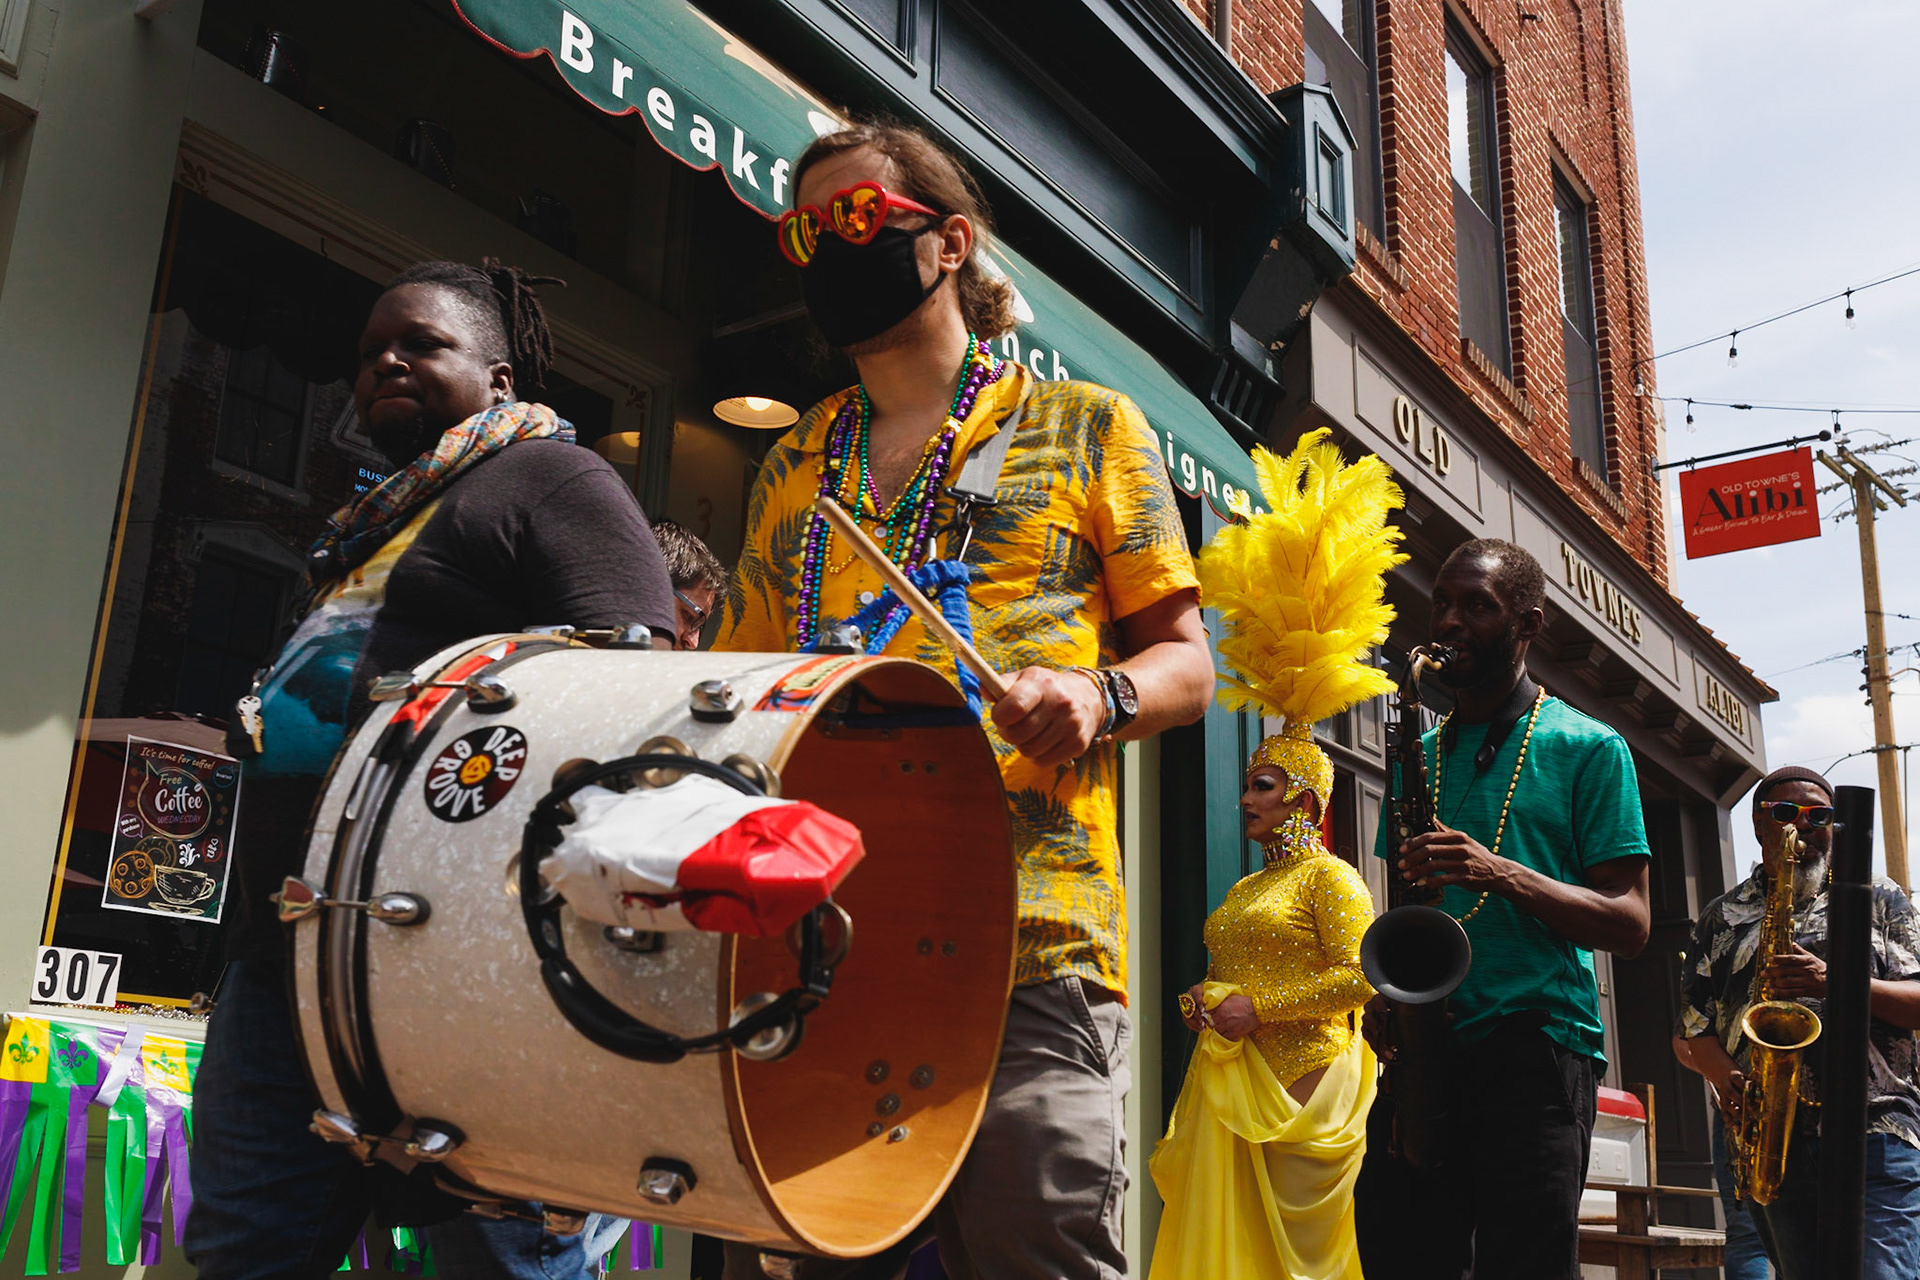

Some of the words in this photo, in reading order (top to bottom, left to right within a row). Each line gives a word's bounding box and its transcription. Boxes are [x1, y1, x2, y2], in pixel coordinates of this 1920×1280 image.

[560, 9, 790, 206] Breakf
[987, 330, 1070, 382] nch
[1393, 394, 1451, 476] OLD
[1694, 480, 1808, 527] Alibi
[1721, 481, 1743, 495] OLD
[1744, 471, 1800, 489] TOWNE'S
[1561, 542, 1643, 645] TOWNES
[1706, 676, 1745, 736] ALIBI
[140, 746, 157, 758] It's
[158, 751, 177, 762] time
[177, 753, 191, 764] for
[159, 773, 182, 786] Free
[429, 739, 486, 818] GROOVE
[483, 727, 525, 781] DEEP
[155, 785, 203, 814] Coffee
[157, 814, 202, 824] WEDNESDAY
[37, 948, 119, 1005] 307
